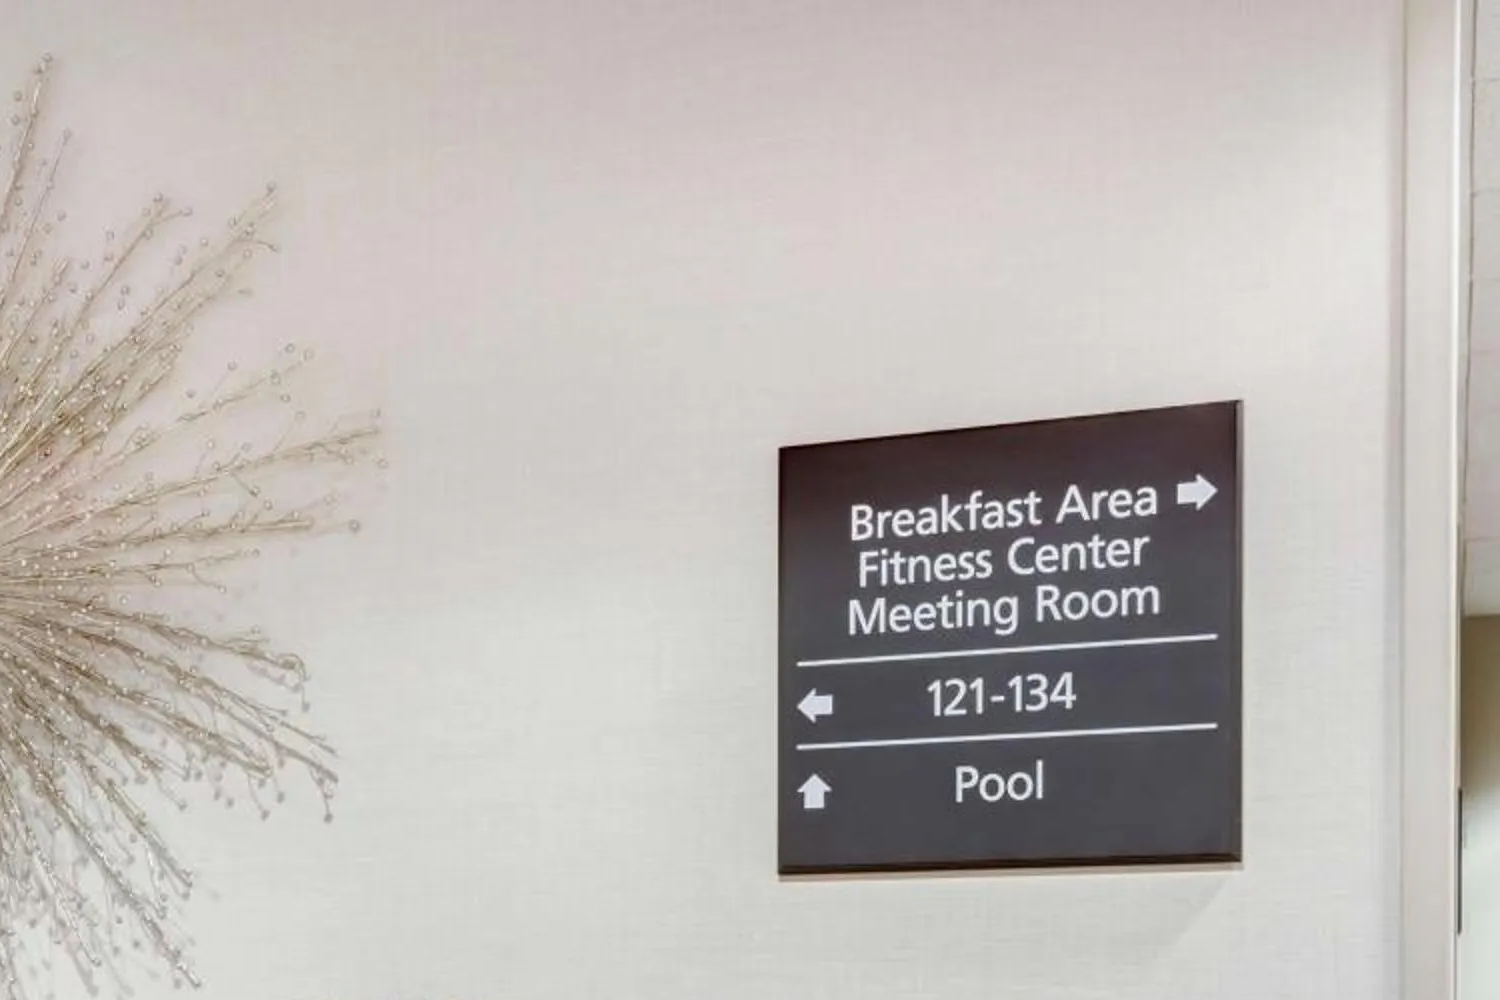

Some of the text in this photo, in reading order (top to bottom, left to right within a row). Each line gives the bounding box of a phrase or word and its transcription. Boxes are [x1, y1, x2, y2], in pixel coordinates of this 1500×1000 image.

[850, 484, 1159, 542] Breakfast Area
[858, 534, 1150, 588] Fitness Center
[848, 584, 1160, 636] Meeting Room
[926, 671, 1077, 717] 121-134
[954, 759, 1044, 803] Pool
